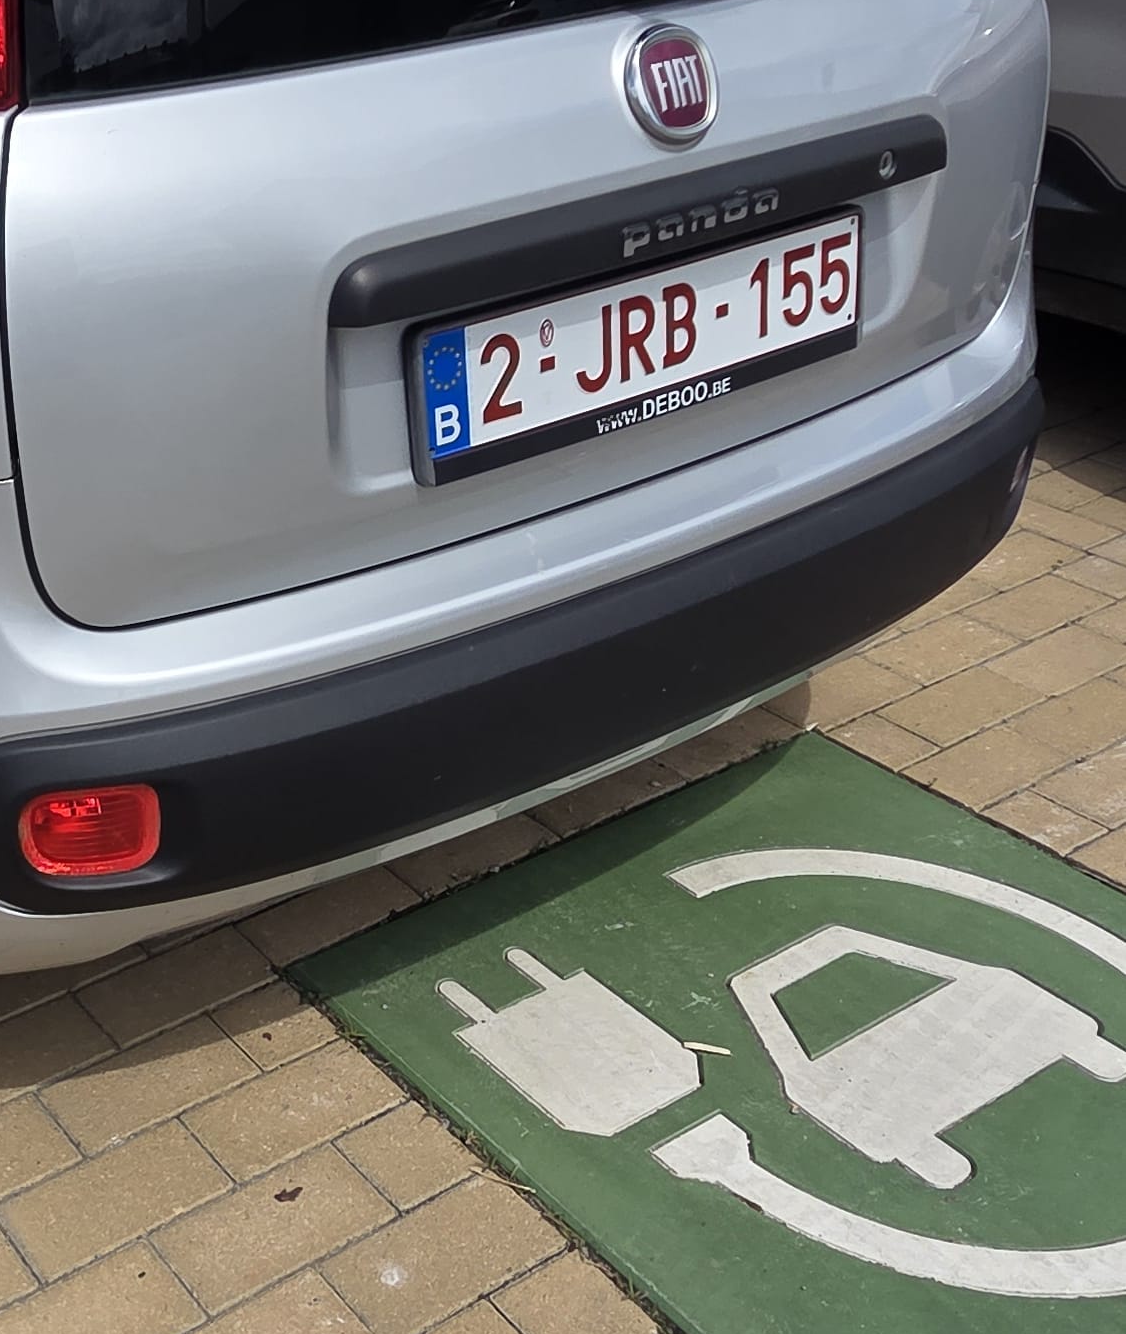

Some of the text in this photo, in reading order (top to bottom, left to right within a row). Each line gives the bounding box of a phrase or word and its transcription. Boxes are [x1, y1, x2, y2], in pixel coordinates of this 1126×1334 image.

[650, 54, 703, 113] FIAT
[622, 186, 779, 258] panda
[434, 404, 461, 447] B
